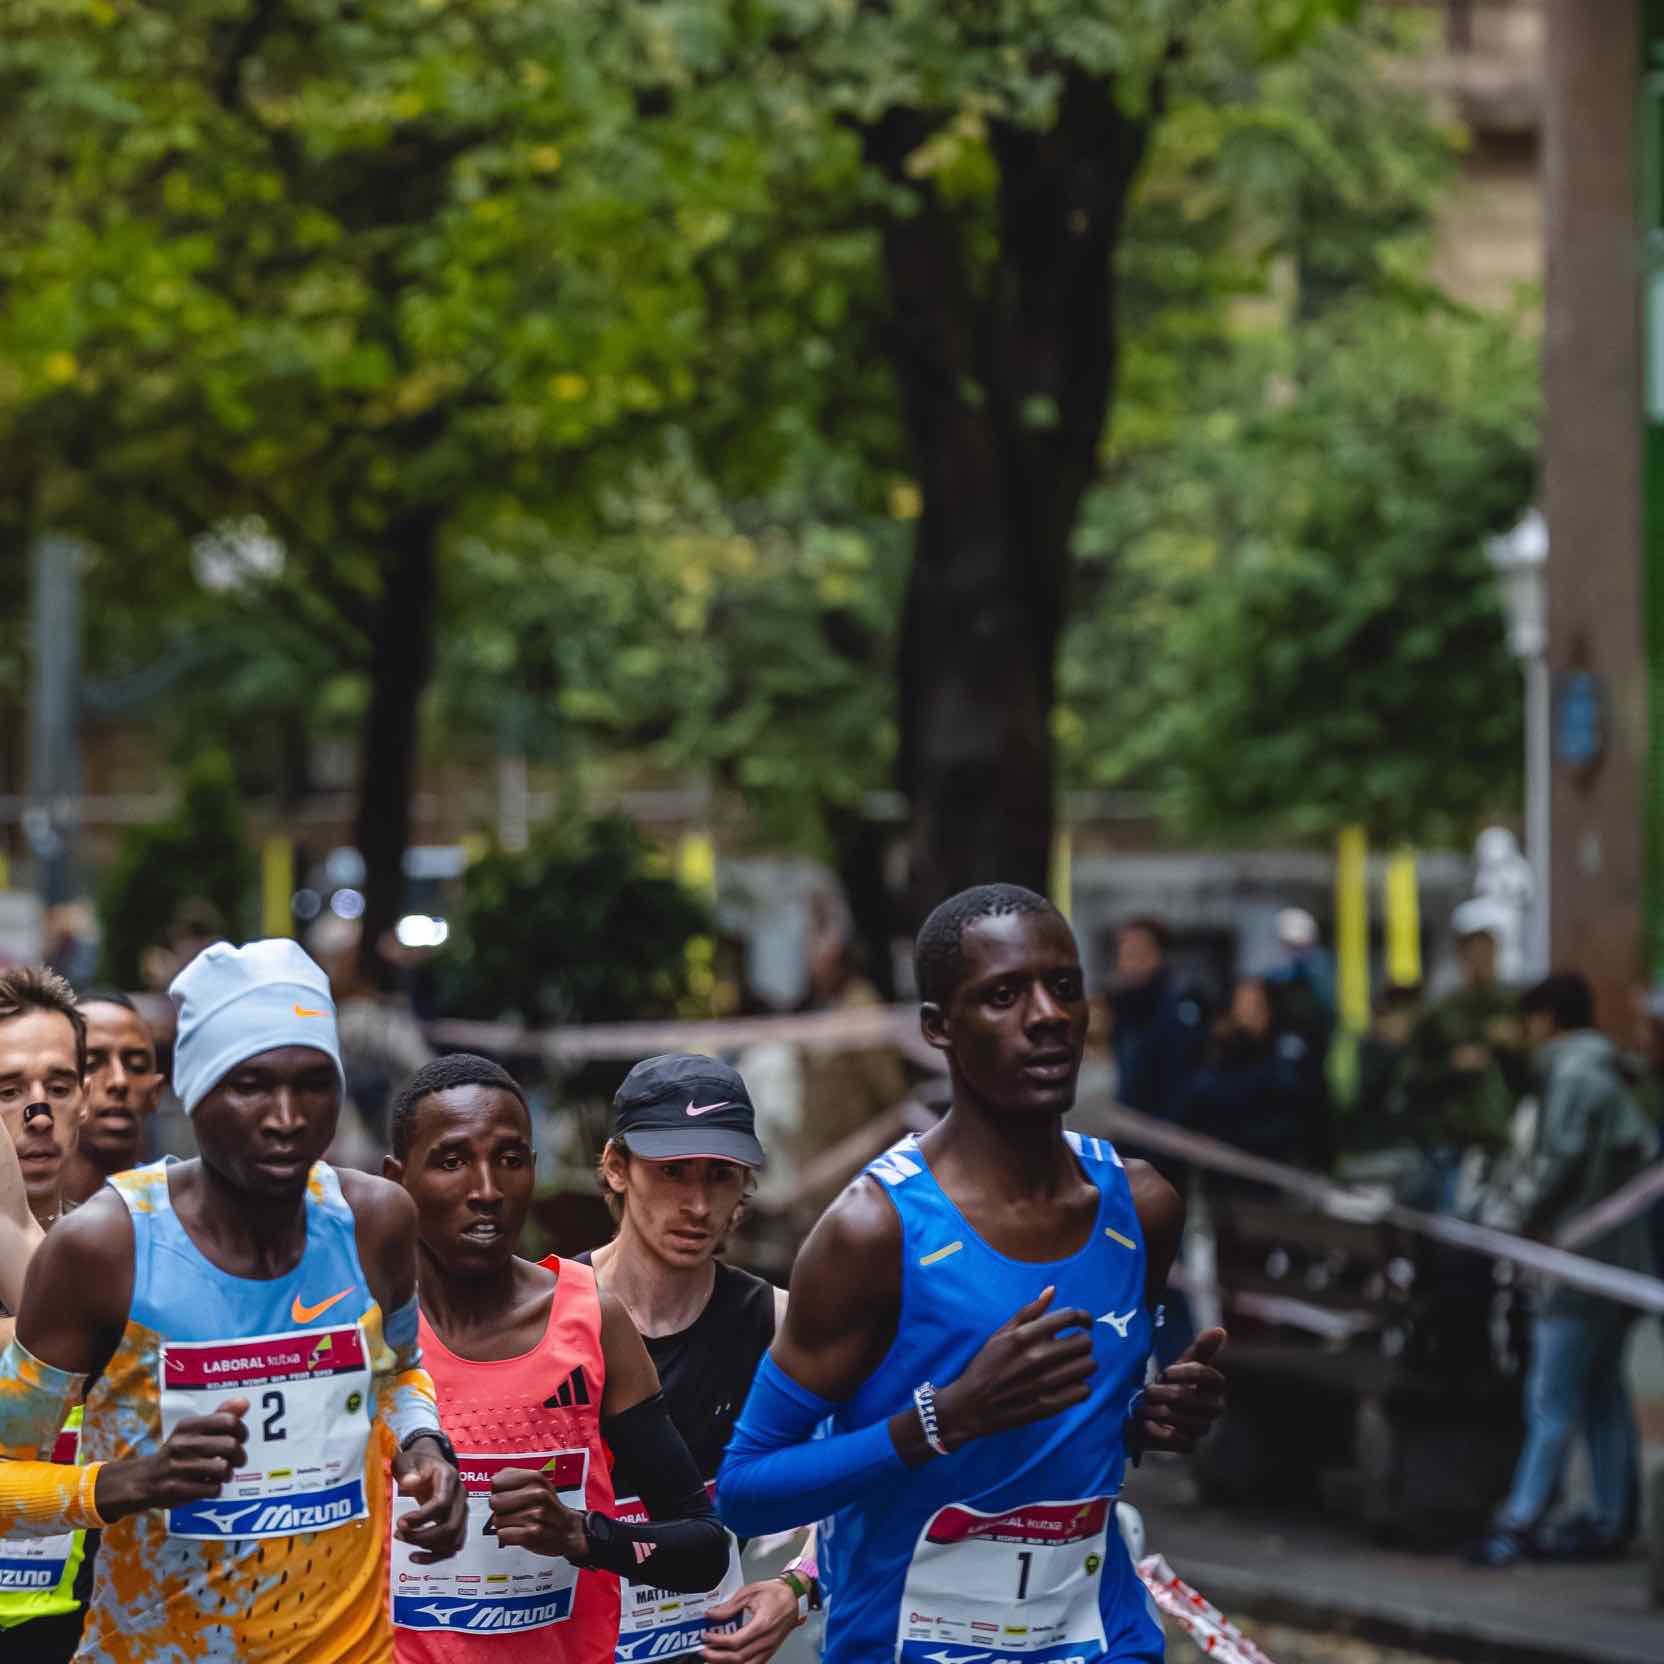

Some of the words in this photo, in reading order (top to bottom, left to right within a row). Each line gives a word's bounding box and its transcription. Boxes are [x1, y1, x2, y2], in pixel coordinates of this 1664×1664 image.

[202, 1355, 266, 1374] LABORAL
[262, 1390, 287, 1442] 2
[458, 1471, 493, 1483] ORAL
[1017, 1551, 1033, 1600] 1
